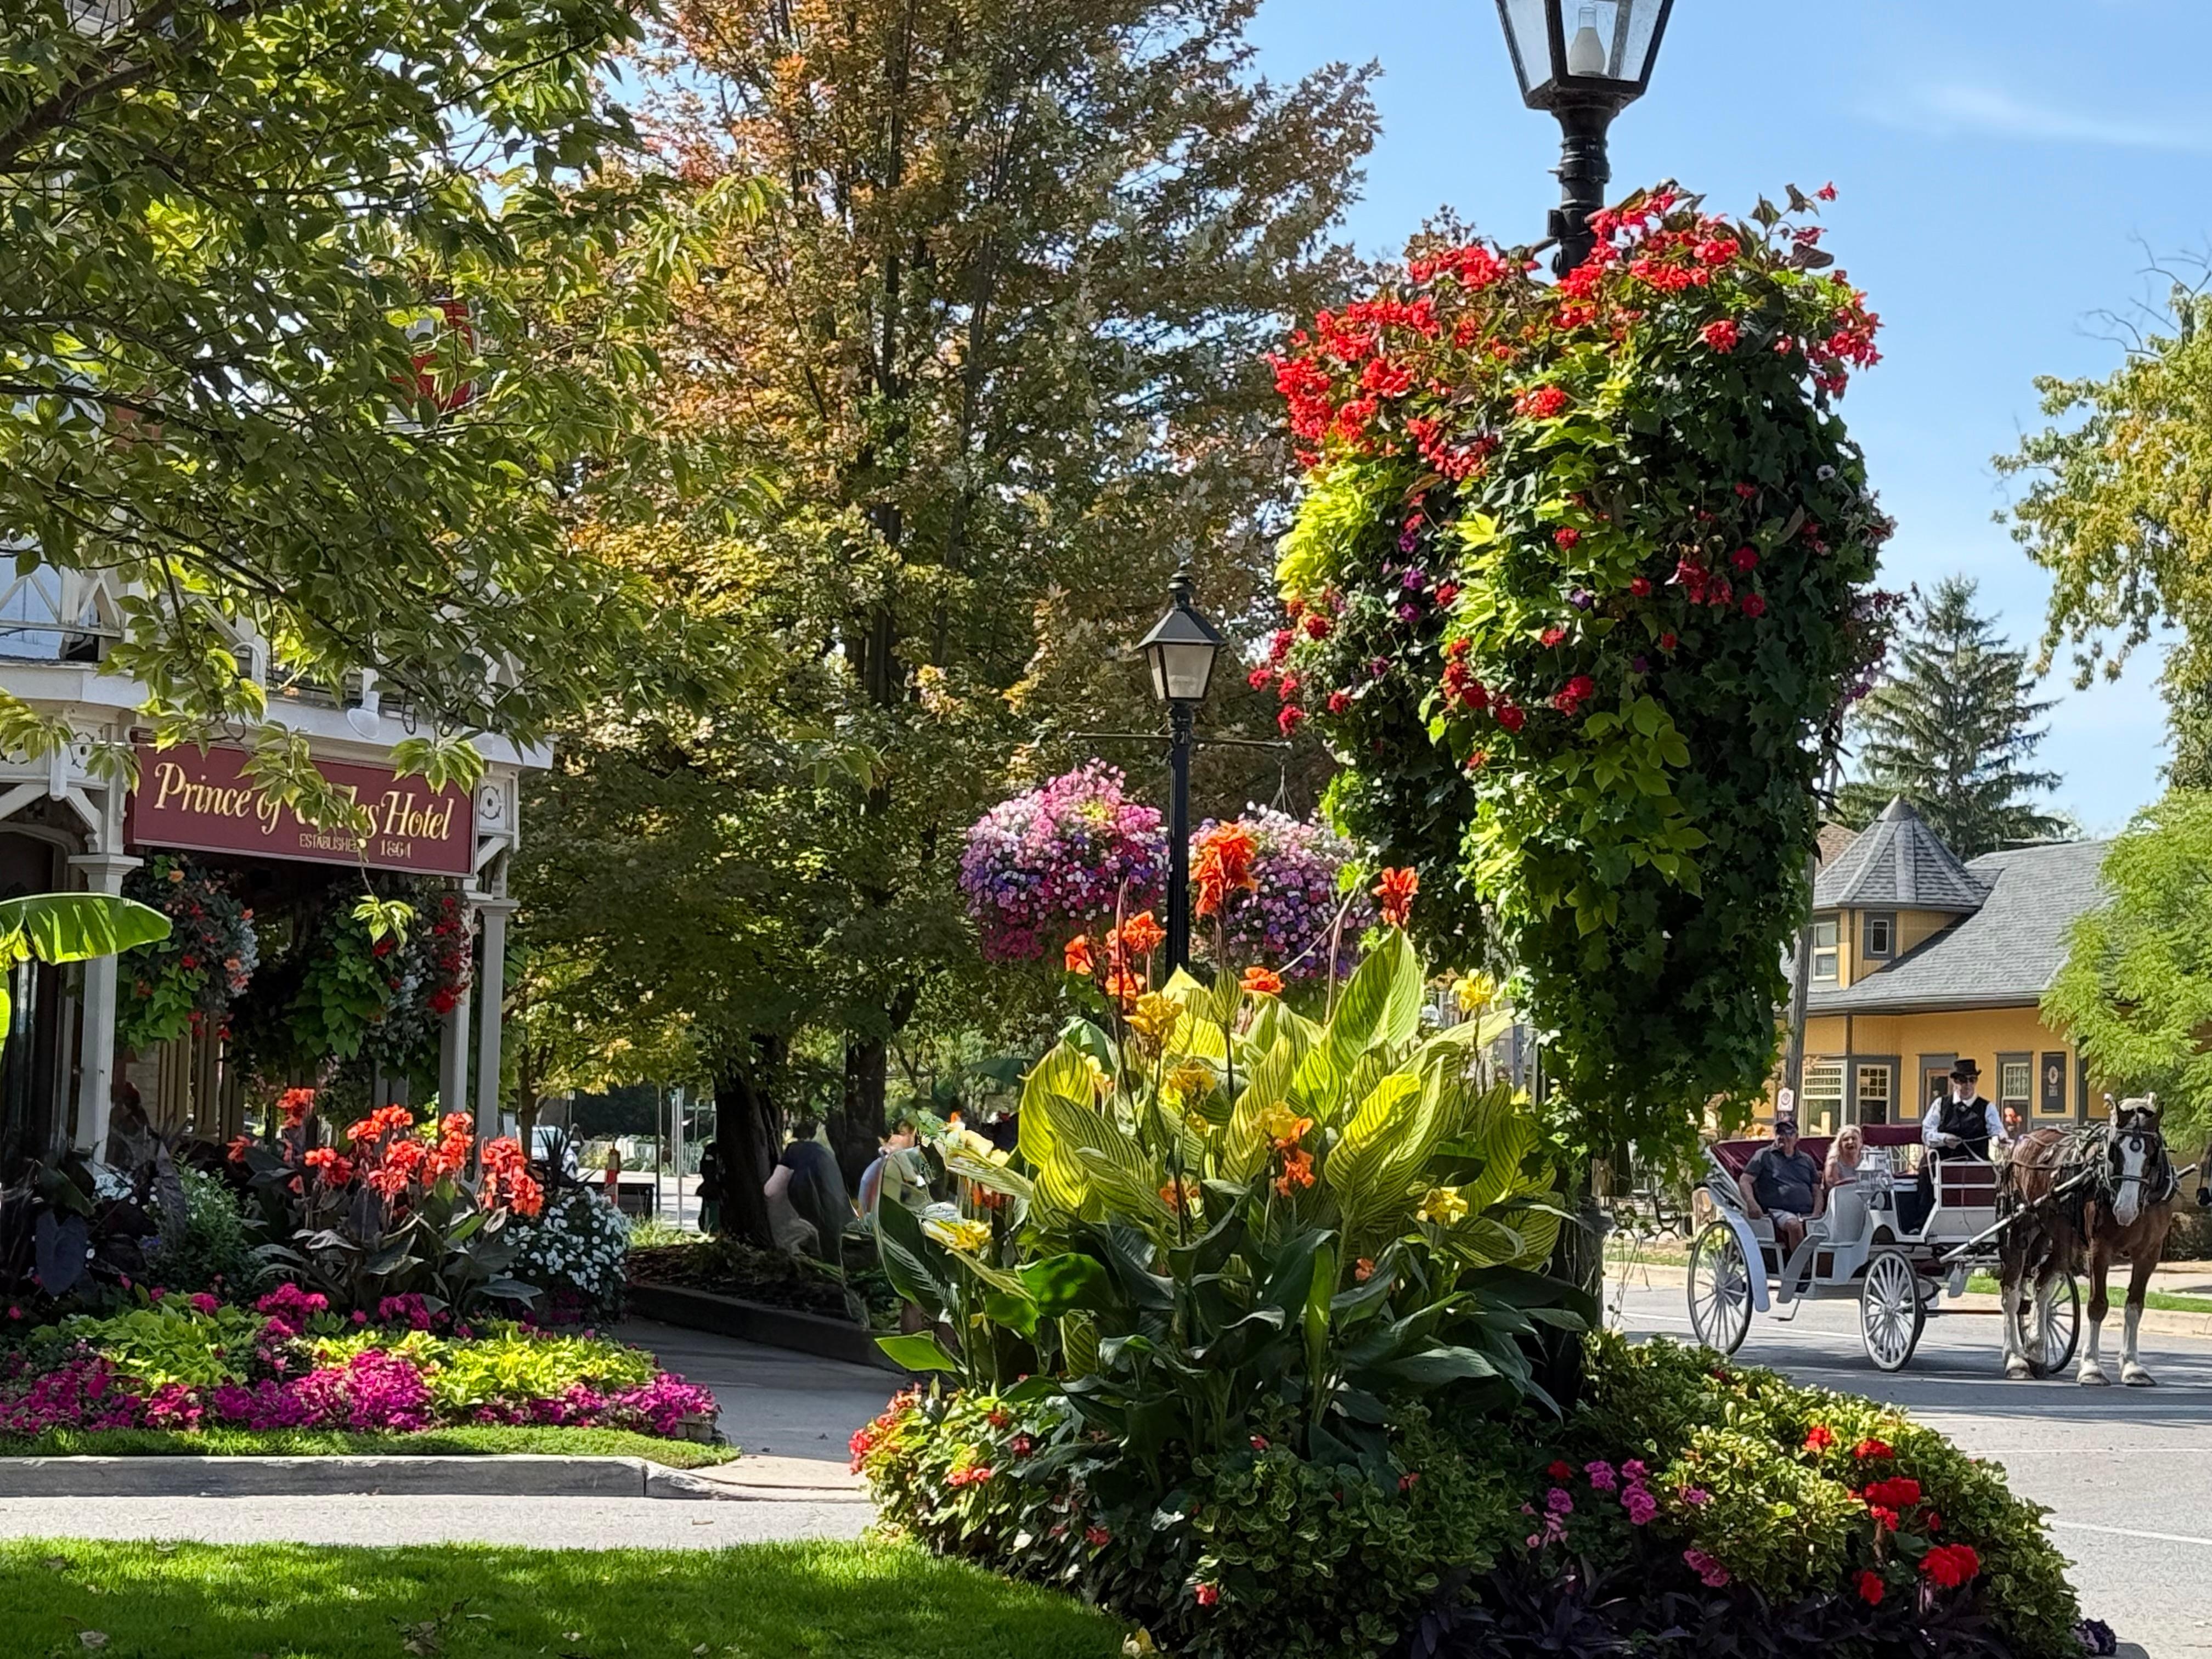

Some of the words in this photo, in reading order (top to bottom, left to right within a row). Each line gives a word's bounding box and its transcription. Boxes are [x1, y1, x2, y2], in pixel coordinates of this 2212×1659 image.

[154, 762, 253, 817] Prince
[257, 791, 283, 835] of
[381, 791, 454, 840] Hotel
[299, 833, 360, 853] ESTABLISHE
